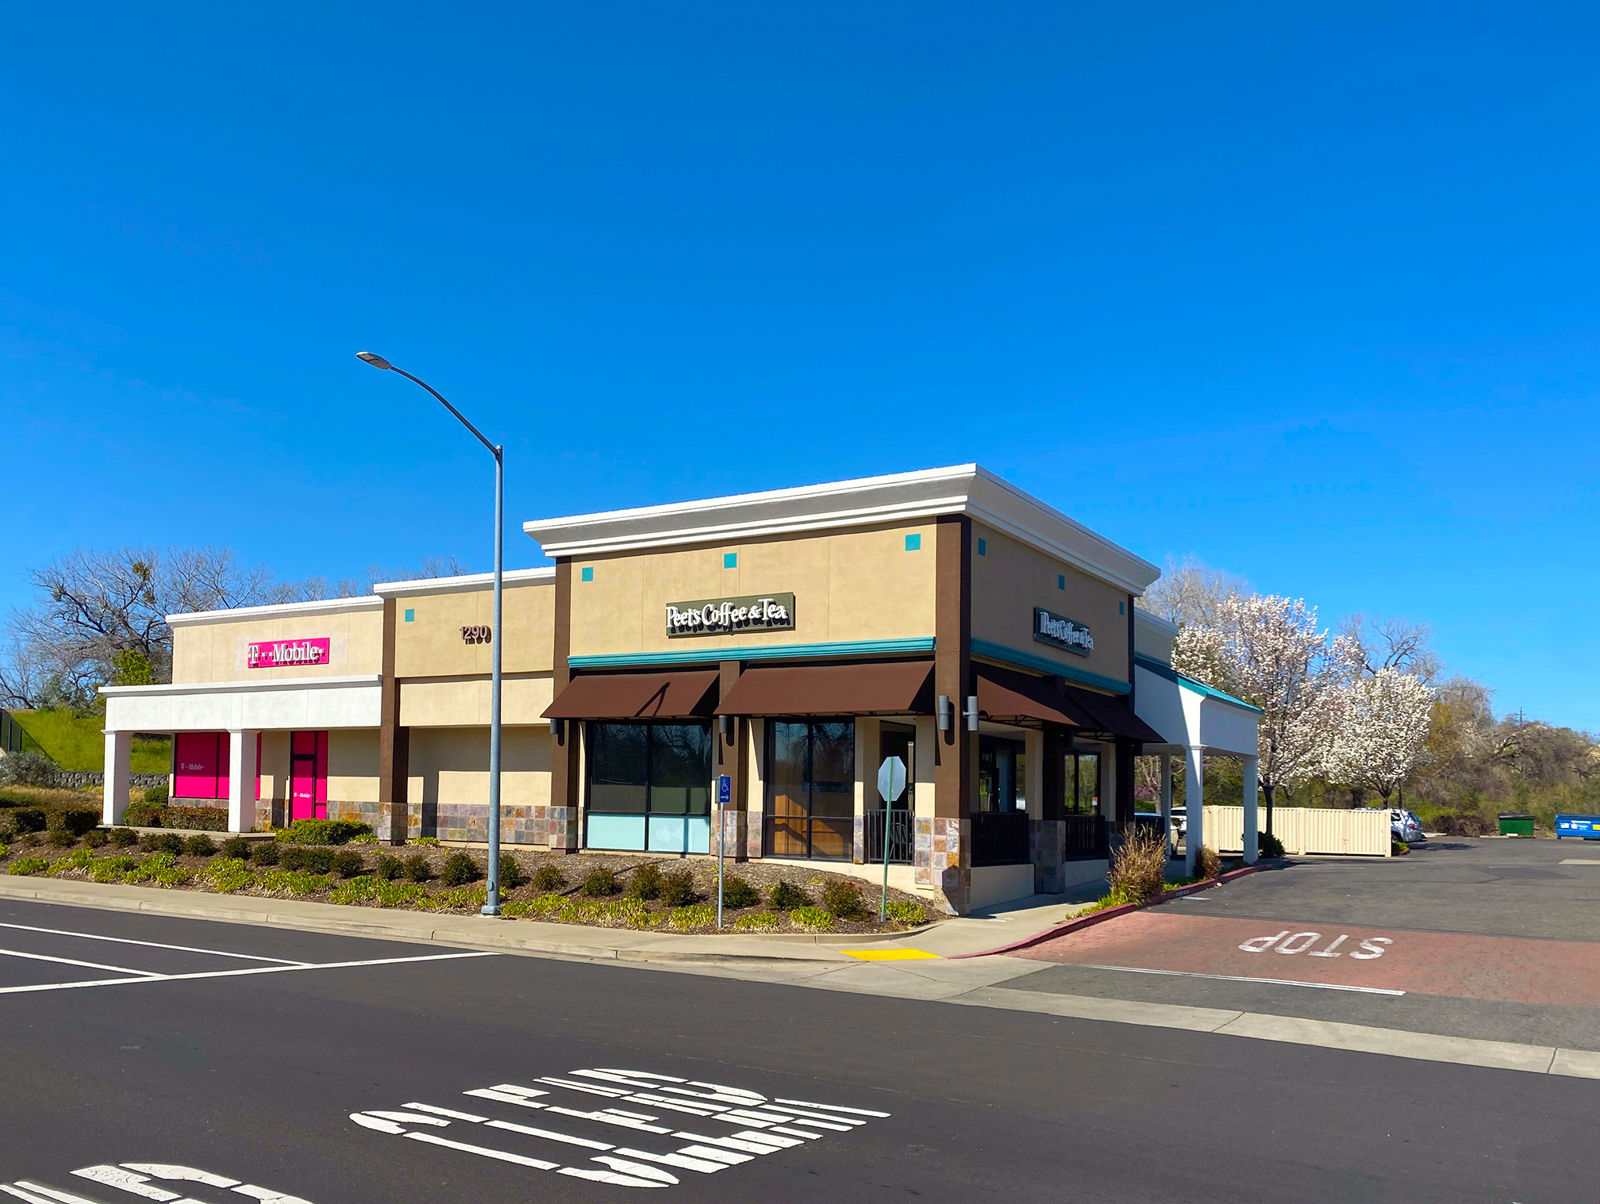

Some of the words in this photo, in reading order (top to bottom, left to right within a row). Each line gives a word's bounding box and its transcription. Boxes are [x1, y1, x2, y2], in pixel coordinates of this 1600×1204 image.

[701, 602, 748, 626] Coffee
[748, 605, 761, 619] &
[758, 598, 788, 620] Tea
[459, 625, 488, 640] 1290
[1238, 930, 1393, 960] STOP
[349, 1067, 891, 1189] CLEAR
